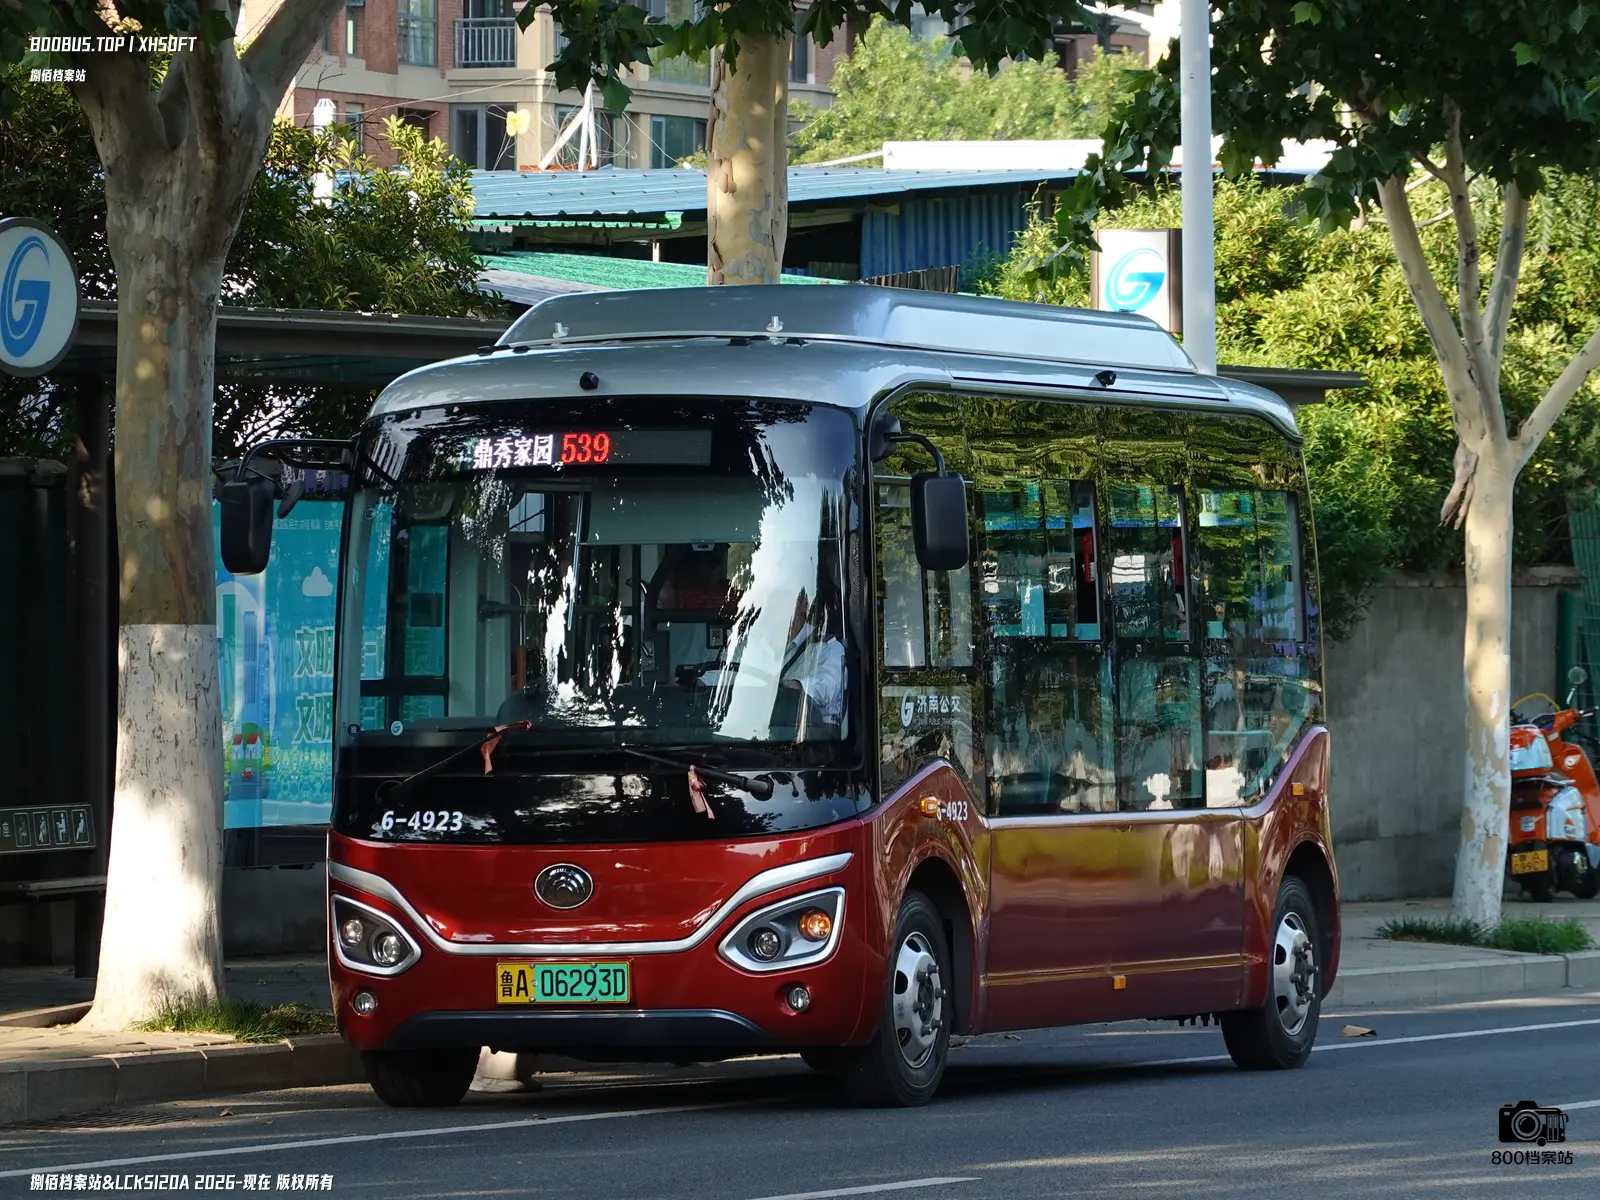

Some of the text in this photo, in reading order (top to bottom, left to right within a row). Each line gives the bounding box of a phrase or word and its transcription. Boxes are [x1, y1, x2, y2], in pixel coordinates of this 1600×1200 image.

[472, 433, 611, 469] 鼎秀家园 539
[917, 694, 961, 713] 济南公交
[381, 810, 463, 831] 6-4923
[500, 968, 626, 998] 鲁A 06293D
